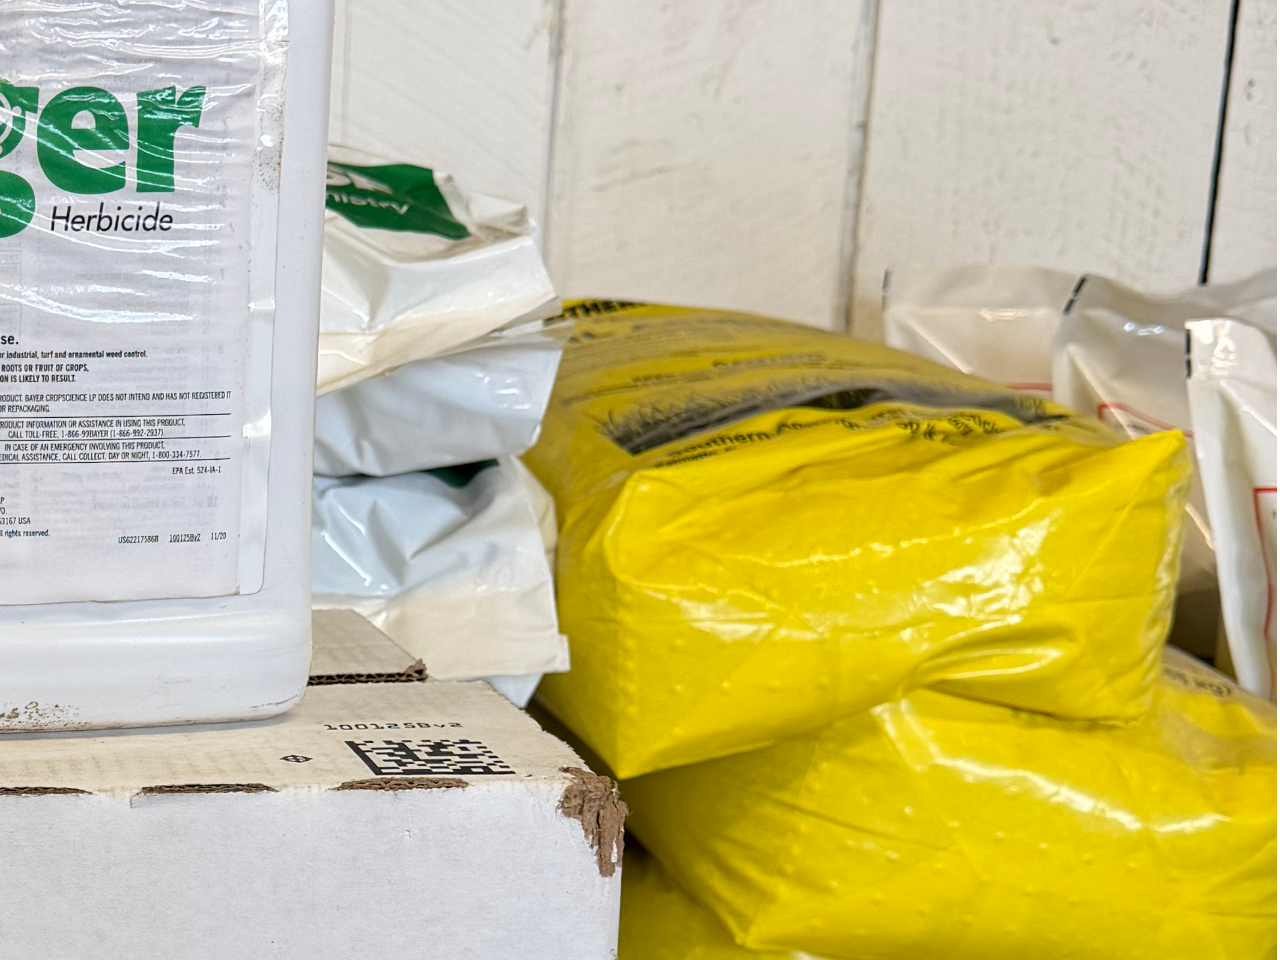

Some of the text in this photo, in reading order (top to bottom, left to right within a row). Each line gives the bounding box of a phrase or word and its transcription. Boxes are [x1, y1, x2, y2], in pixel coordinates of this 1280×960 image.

[50, 202, 174, 233] Herbicide
[106, 350, 123, 358] weed
[1, 364, 22, 372] ROOTS
[24, 364, 33, 372] OR
[35, 364, 54, 372] FRUIT
[55, 364, 63, 372] OF
[10, 375, 17, 383] IS
[18, 375, 40, 383] LIKELY
[41, 374, 50, 383] TO
